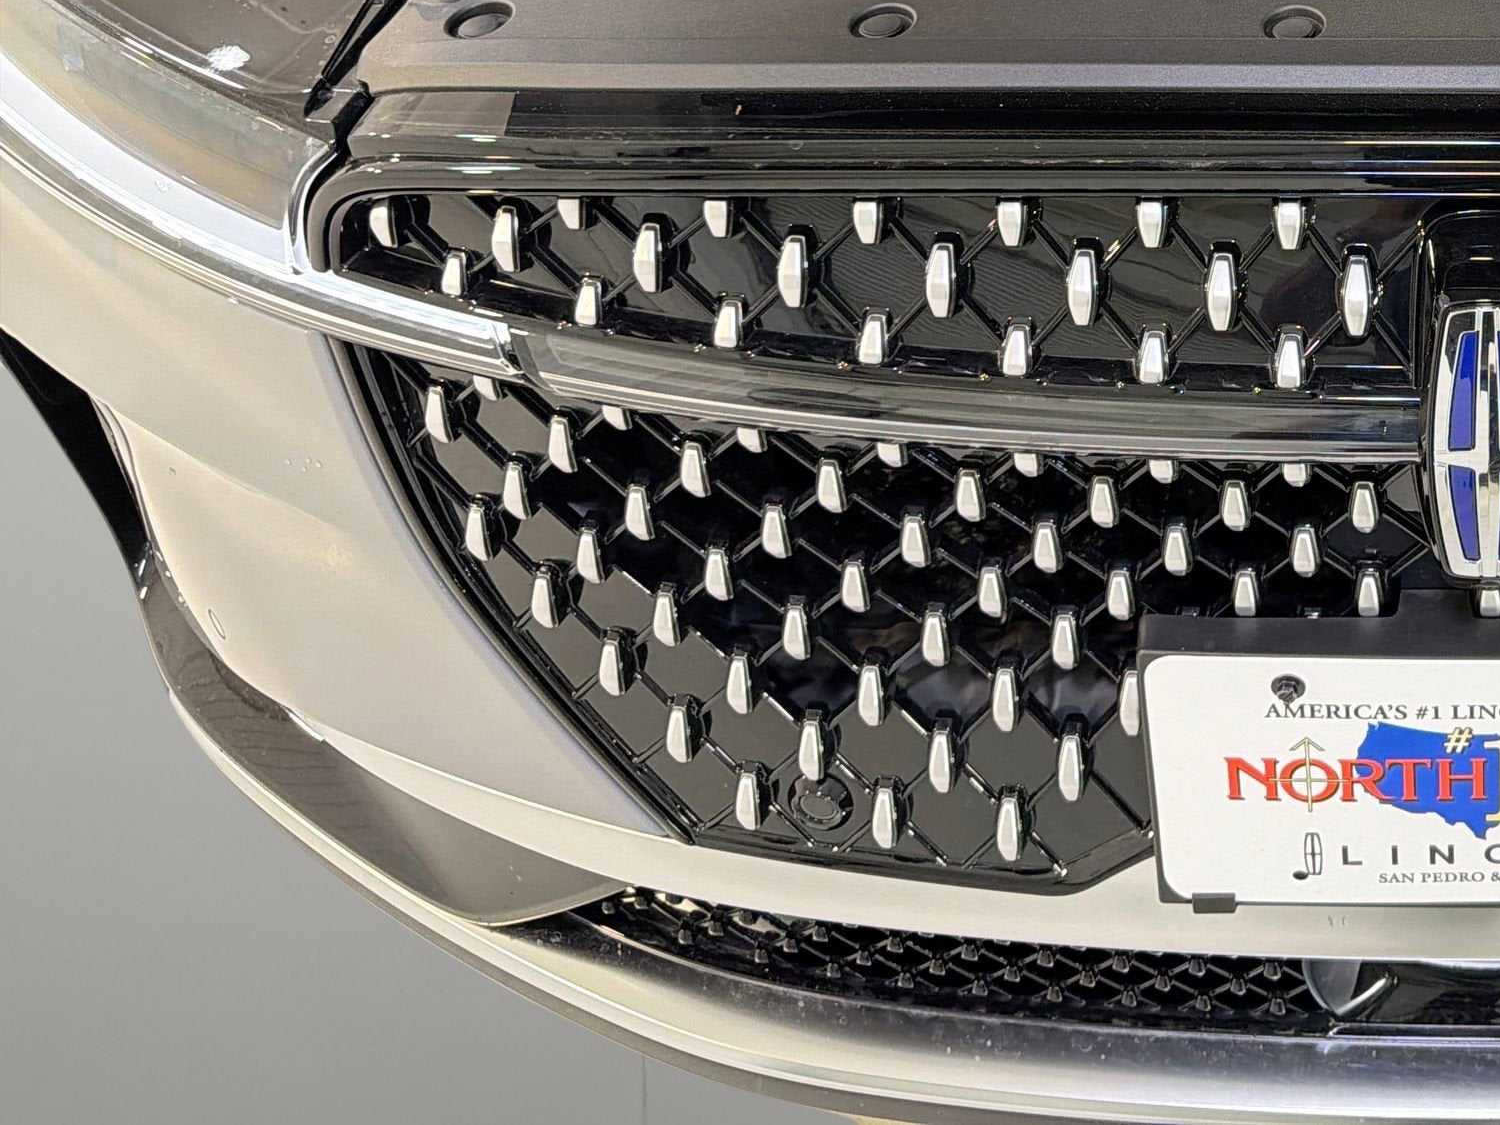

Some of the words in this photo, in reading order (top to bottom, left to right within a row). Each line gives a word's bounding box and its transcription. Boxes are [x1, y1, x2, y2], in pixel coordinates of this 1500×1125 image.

[1264, 702, 1408, 721] AMERICA'S
[1415, 704, 1443, 721] #1
[1223, 756, 1490, 804] NORTH
[1378, 870, 1416, 884] SAN
[1420, 870, 1486, 884] PEDRO
